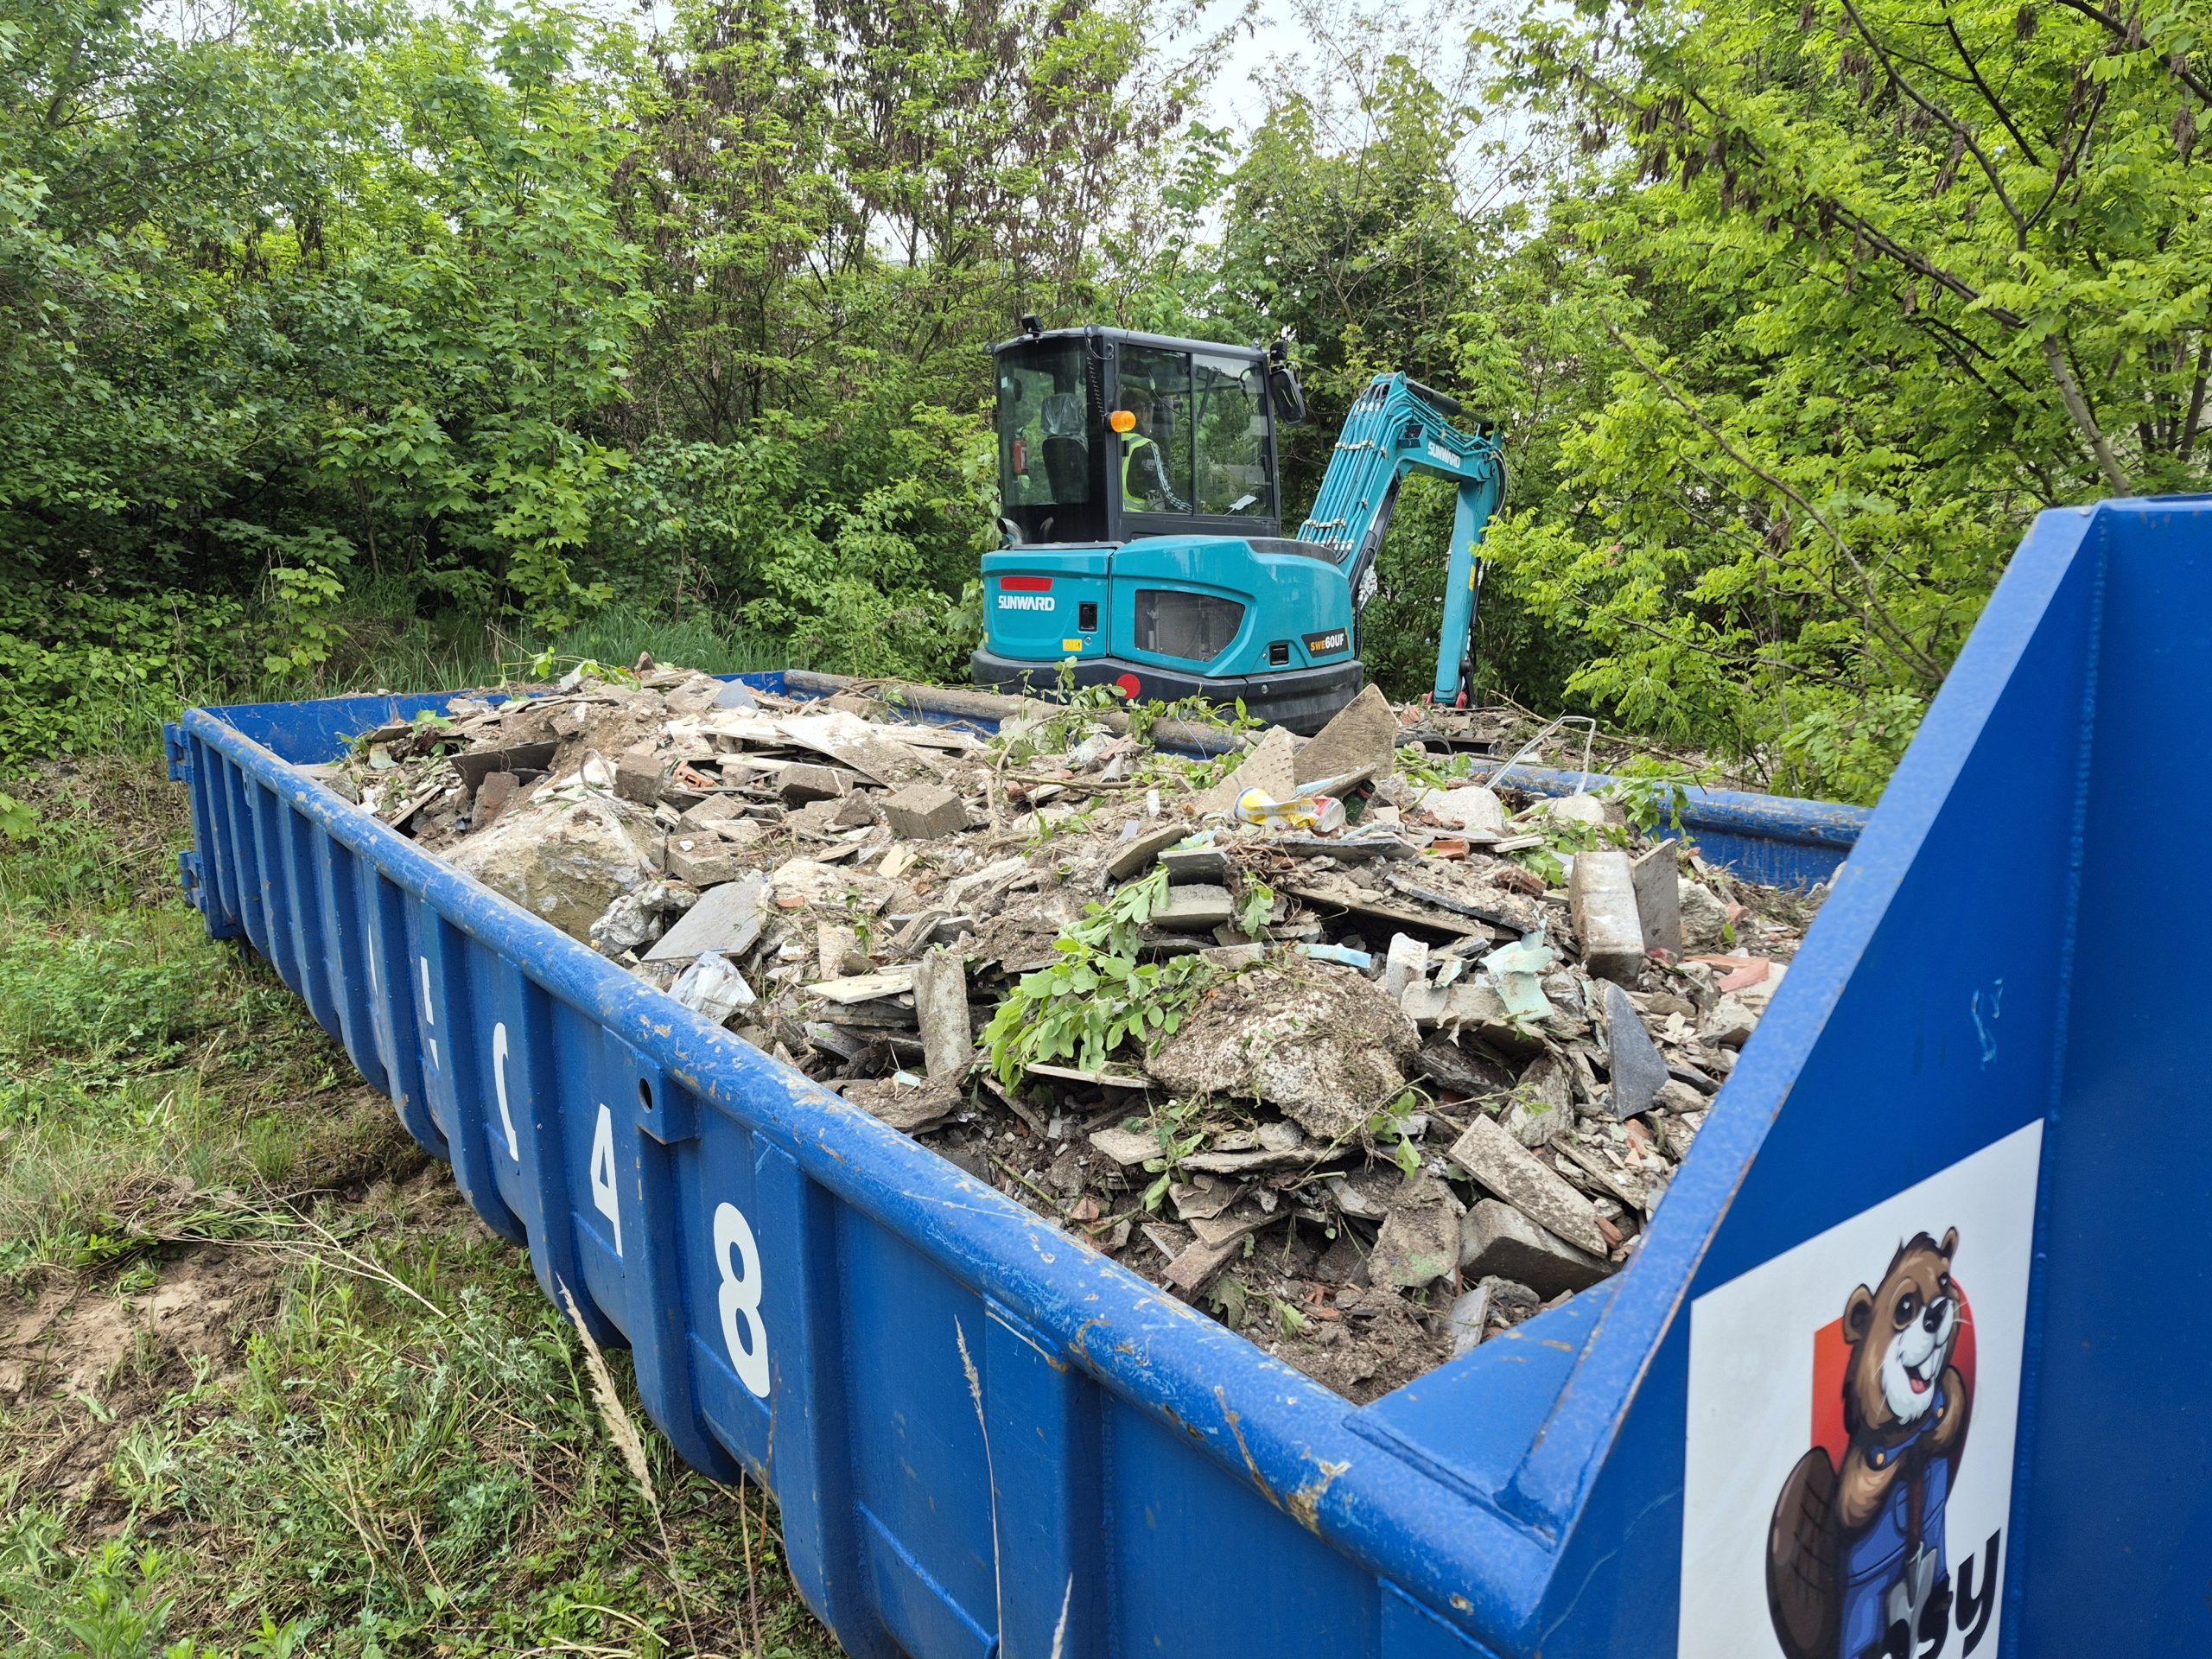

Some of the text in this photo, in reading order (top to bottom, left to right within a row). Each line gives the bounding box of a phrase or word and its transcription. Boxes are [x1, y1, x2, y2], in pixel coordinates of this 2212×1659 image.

[1427, 441, 1460, 469] SUNWARD
[998, 594, 1056, 612] SUNWARD
[1310, 632, 1344, 652] SWE60UF
